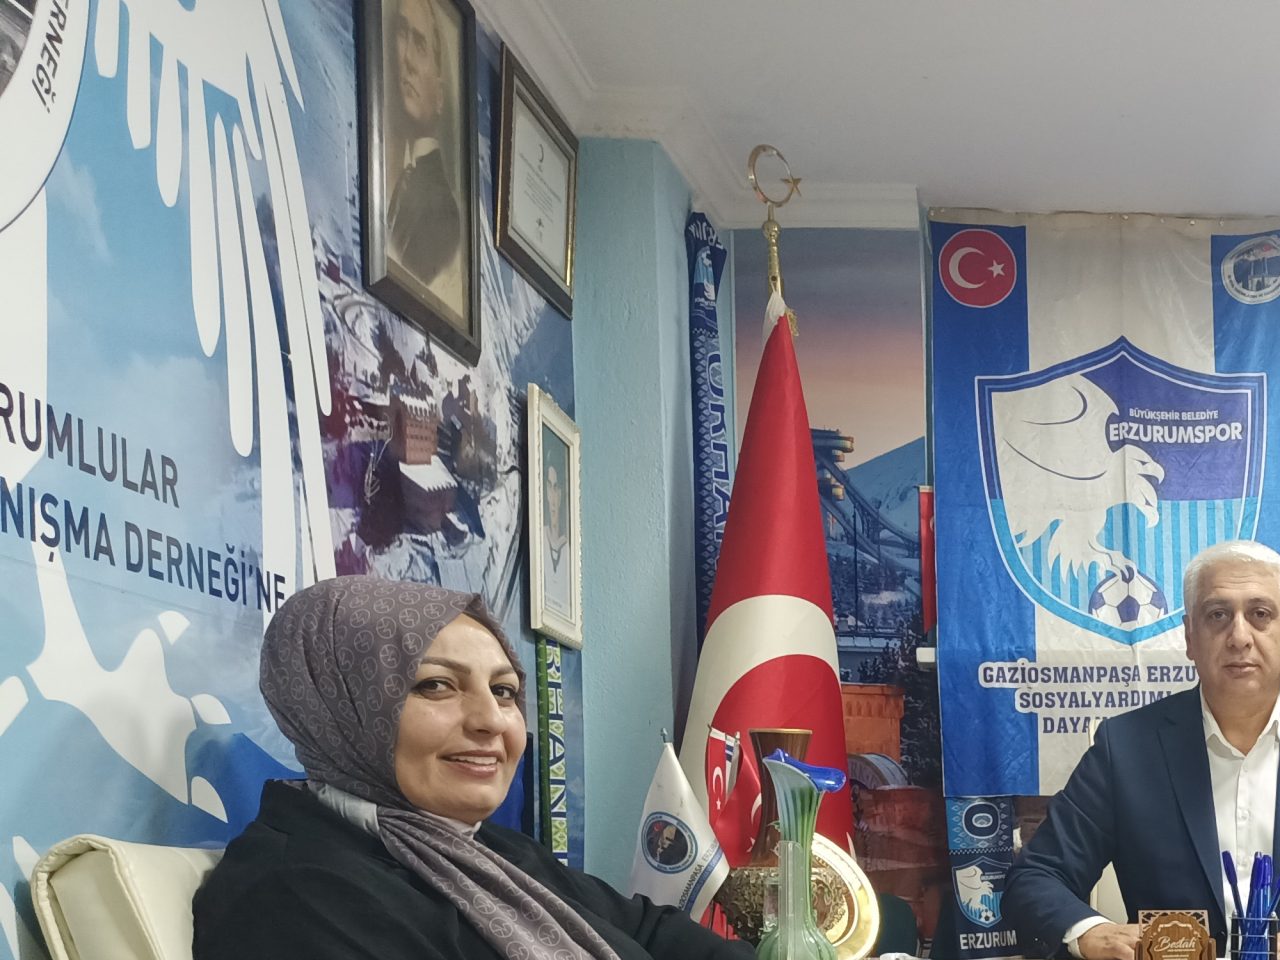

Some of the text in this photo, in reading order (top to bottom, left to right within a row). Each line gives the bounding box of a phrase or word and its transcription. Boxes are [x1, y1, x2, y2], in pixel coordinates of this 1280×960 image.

[32, 0, 69, 114] RNEĞİ
[1129, 407, 1219, 421] BÜYÜKŞEHİR BELEDİYE
[1109, 422, 1243, 443] ERZURUMSPOR
[983, 661, 1141, 687] GAZİOSMANPAŞA
[959, 930, 1017, 950] ERZURUM
